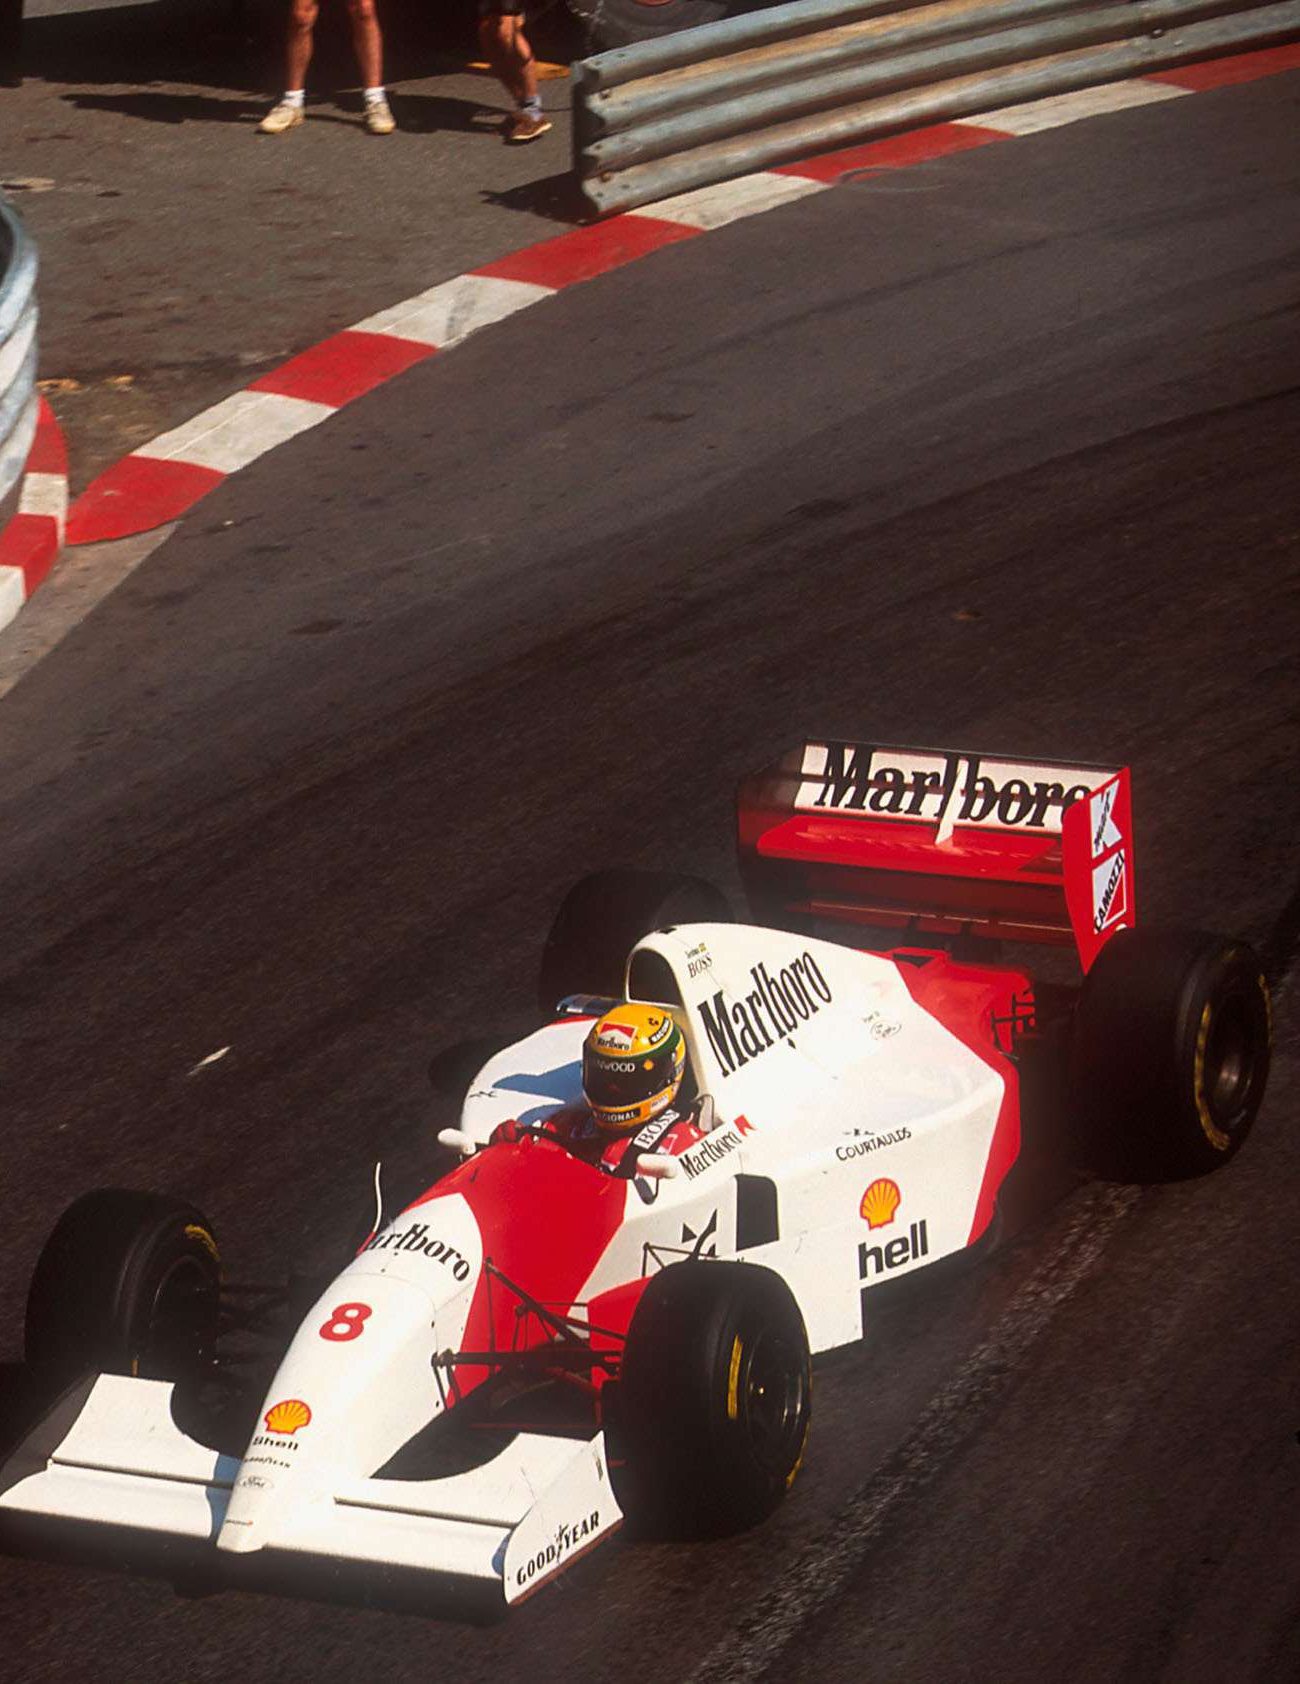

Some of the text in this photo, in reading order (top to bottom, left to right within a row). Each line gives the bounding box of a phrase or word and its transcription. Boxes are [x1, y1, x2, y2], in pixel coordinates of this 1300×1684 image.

[1094, 850, 1125, 933] CAMOZZI
[687, 953, 712, 978] BOSS
[697, 952, 832, 1078] Marlboro
[640, 1110, 678, 1147] BOSS
[835, 1127, 912, 1161] COURTAULDS
[679, 1131, 742, 1180] Marlboro
[368, 1223, 470, 1282] rlboro
[858, 1219, 929, 1280] hell
[319, 1302, 373, 1342] 8
